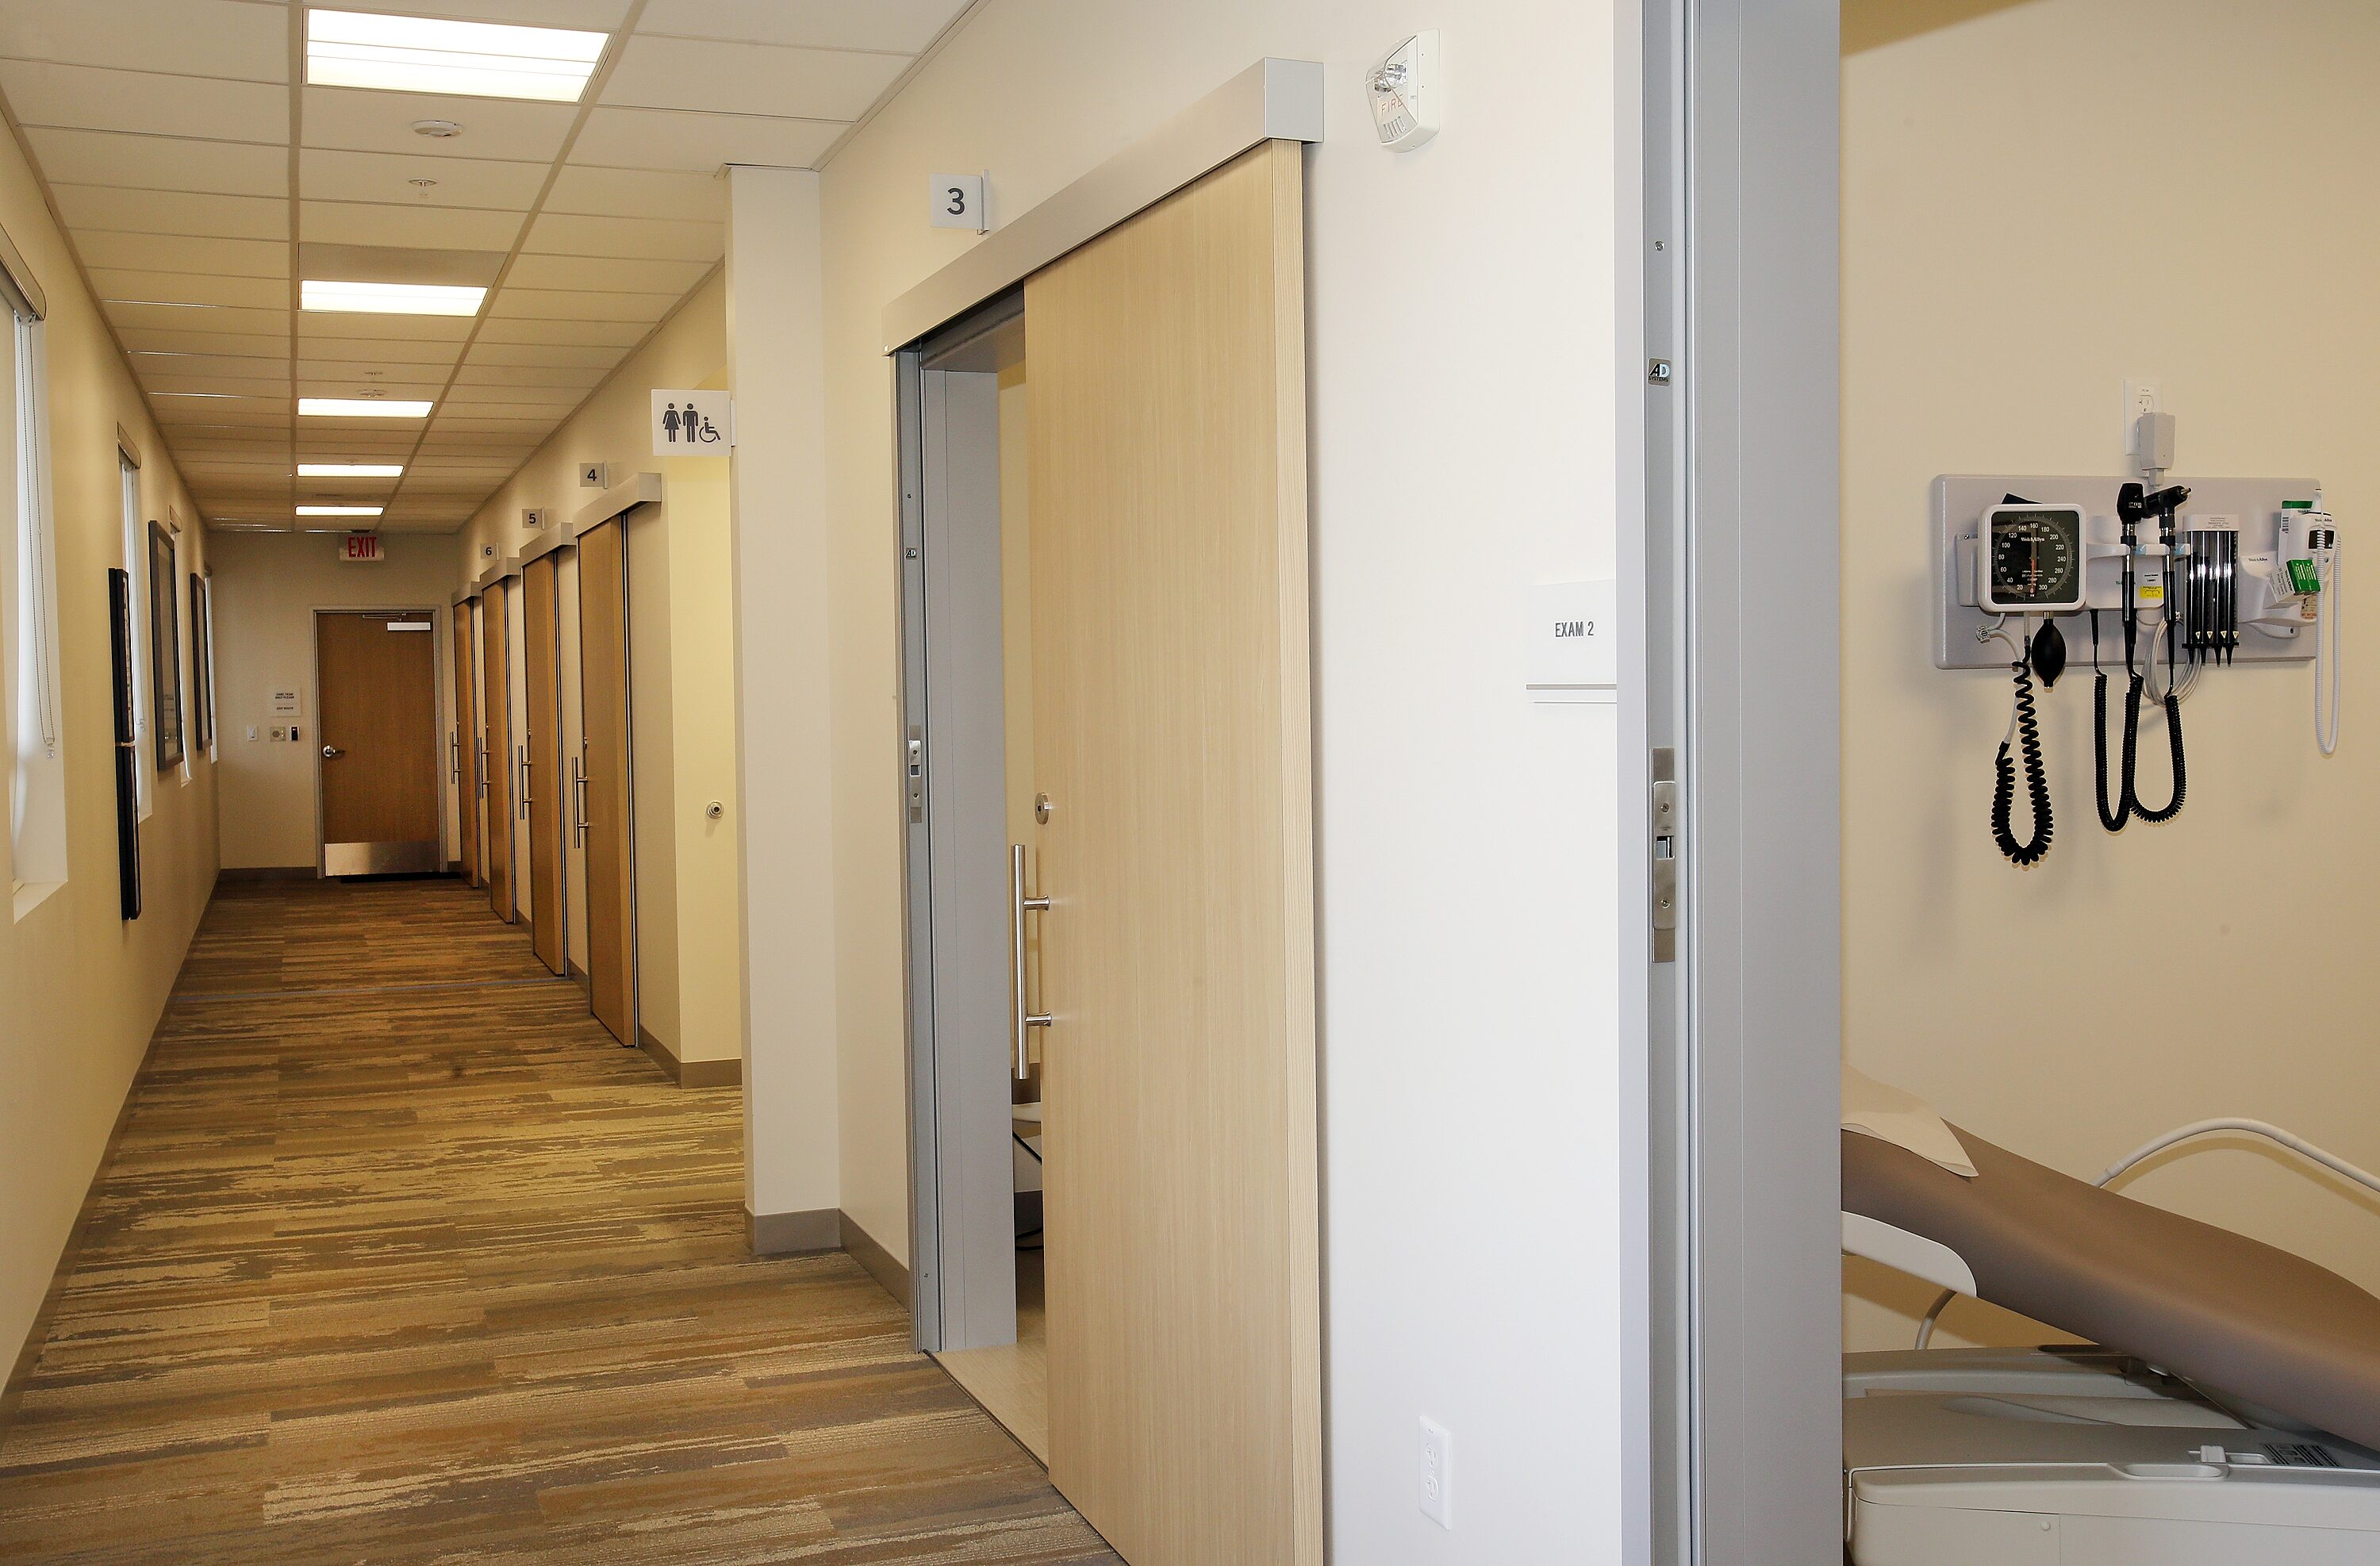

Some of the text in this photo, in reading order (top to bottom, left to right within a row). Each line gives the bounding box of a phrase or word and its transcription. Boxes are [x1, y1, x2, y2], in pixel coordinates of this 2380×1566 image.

[946, 187, 965, 215] 3
[1649, 363, 1670, 378] AD
[587, 469, 597, 482] 4
[528, 513, 536, 524] 5
[347, 536, 377, 558] EXIT
[485, 547, 493, 556] 6
[1555, 621, 1594, 637] EXAM 2
